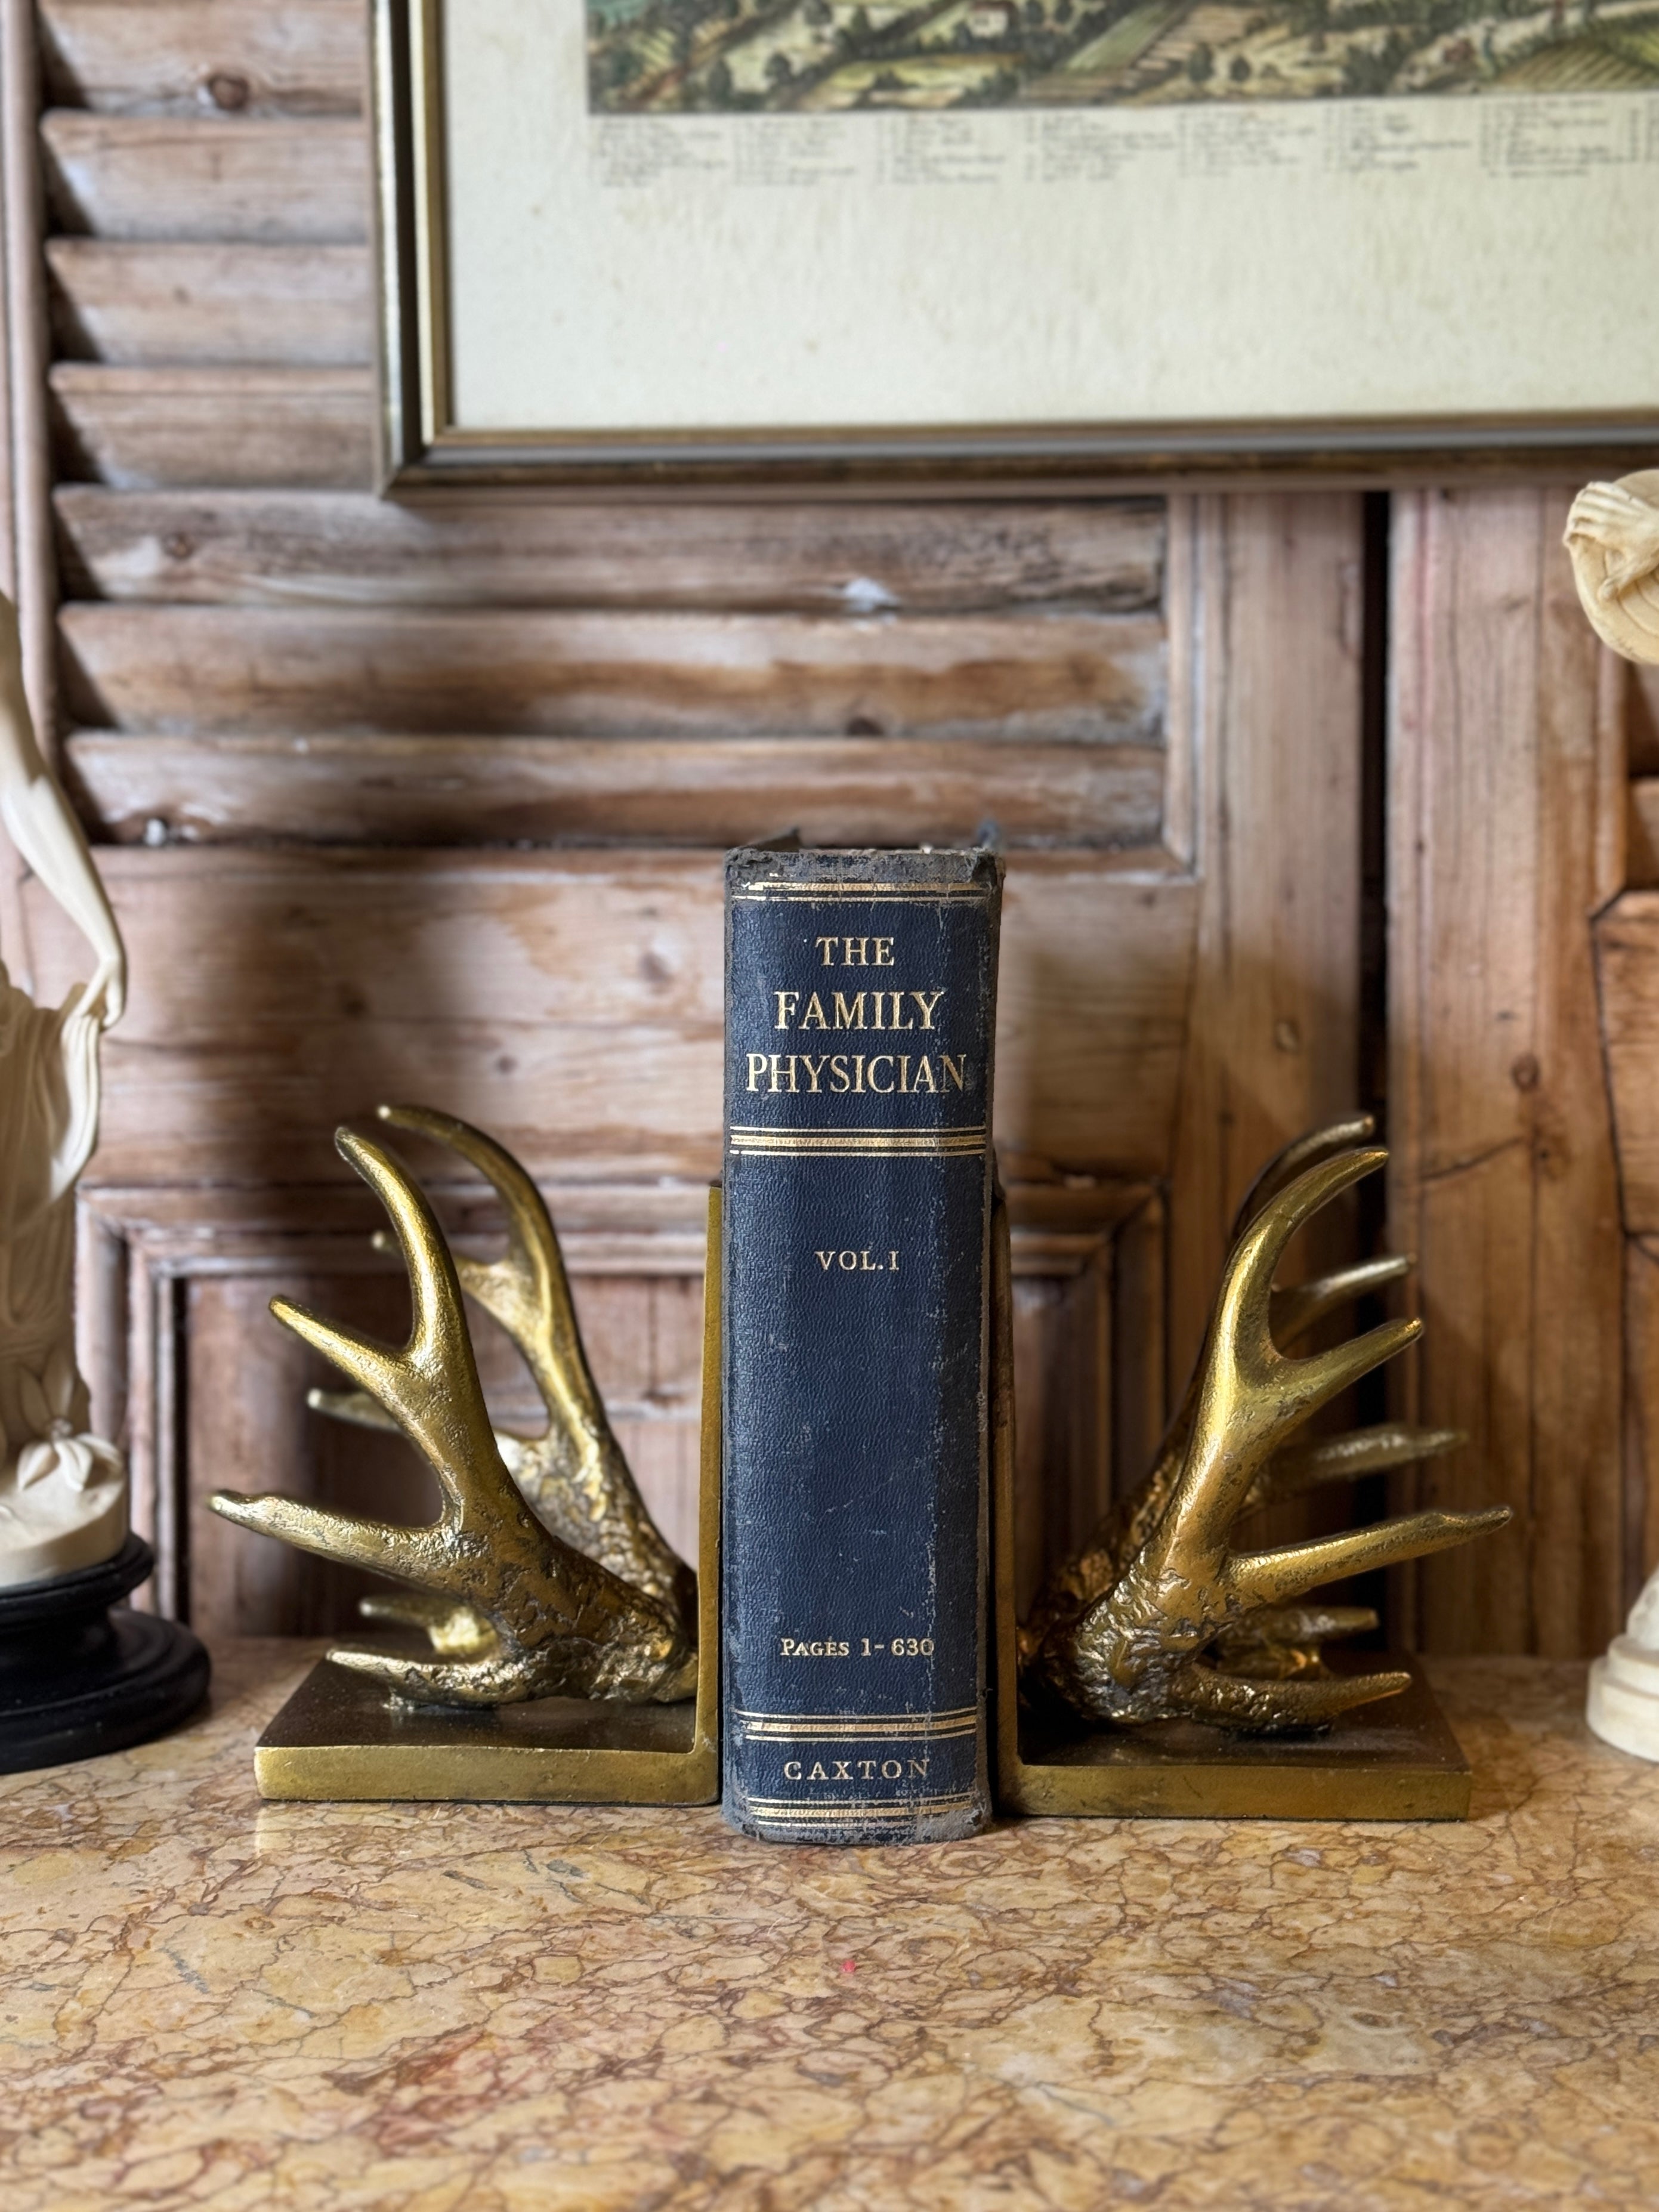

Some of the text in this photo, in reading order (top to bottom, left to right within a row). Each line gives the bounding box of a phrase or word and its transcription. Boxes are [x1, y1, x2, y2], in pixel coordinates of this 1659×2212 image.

[815, 936, 895, 966] THE
[774, 990, 945, 1030] FAMILY
[746, 1053, 967, 1093] PHYSICIAN
[783, 1760, 930, 1781] CAXTON
